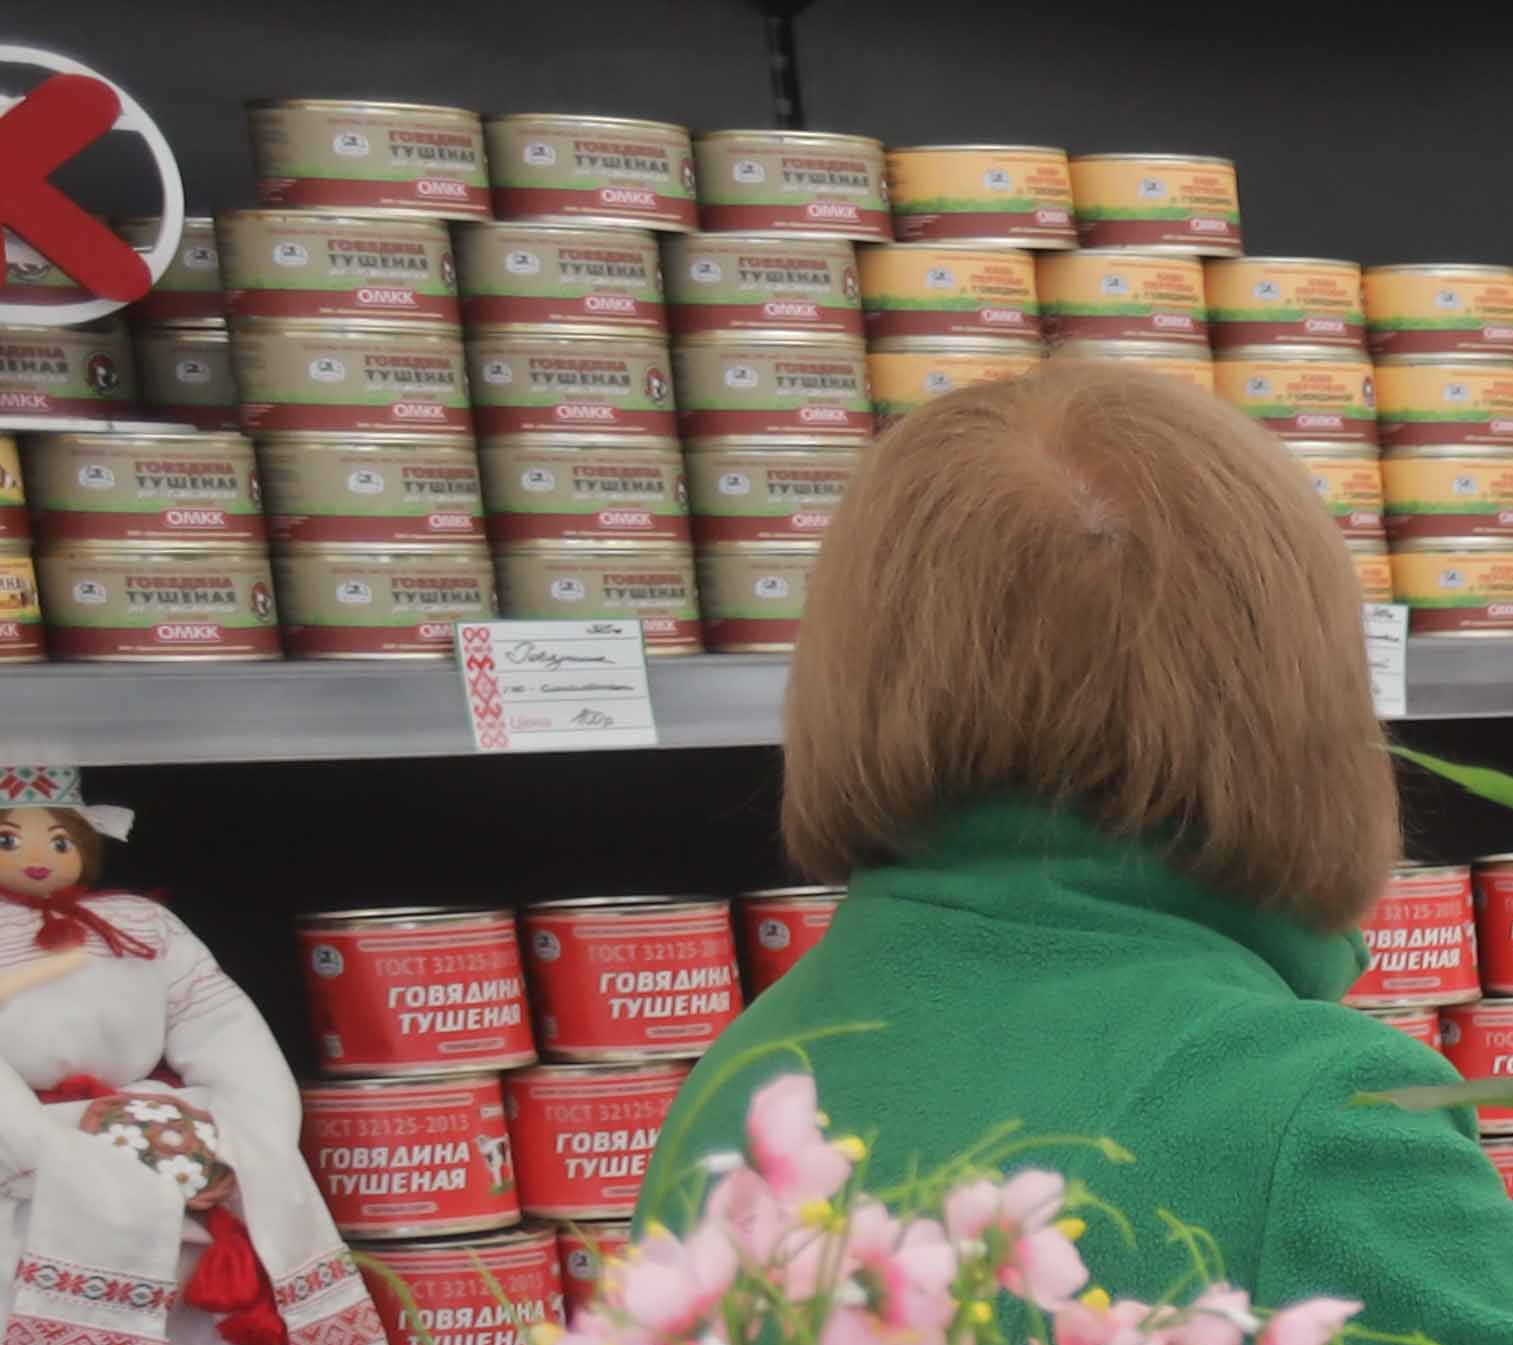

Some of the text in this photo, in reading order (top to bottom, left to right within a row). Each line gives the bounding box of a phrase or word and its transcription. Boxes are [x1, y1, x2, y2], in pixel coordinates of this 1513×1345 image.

[1368, 948, 1461, 972] УШЕНАЯ
[388, 978, 520, 1008] ГОВЯДИНА
[600, 965, 731, 993] ГОВЯДИНА
[399, 1003, 521, 1035] ТУШЕНАЯ
[609, 991, 731, 1019] ТУШЕНАЯ
[319, 1141, 470, 1170] ГОВЯДИНА
[565, 1153, 651, 1179] ТУШЕ
[328, 1168, 467, 1196] ТУШЕНАЯ
